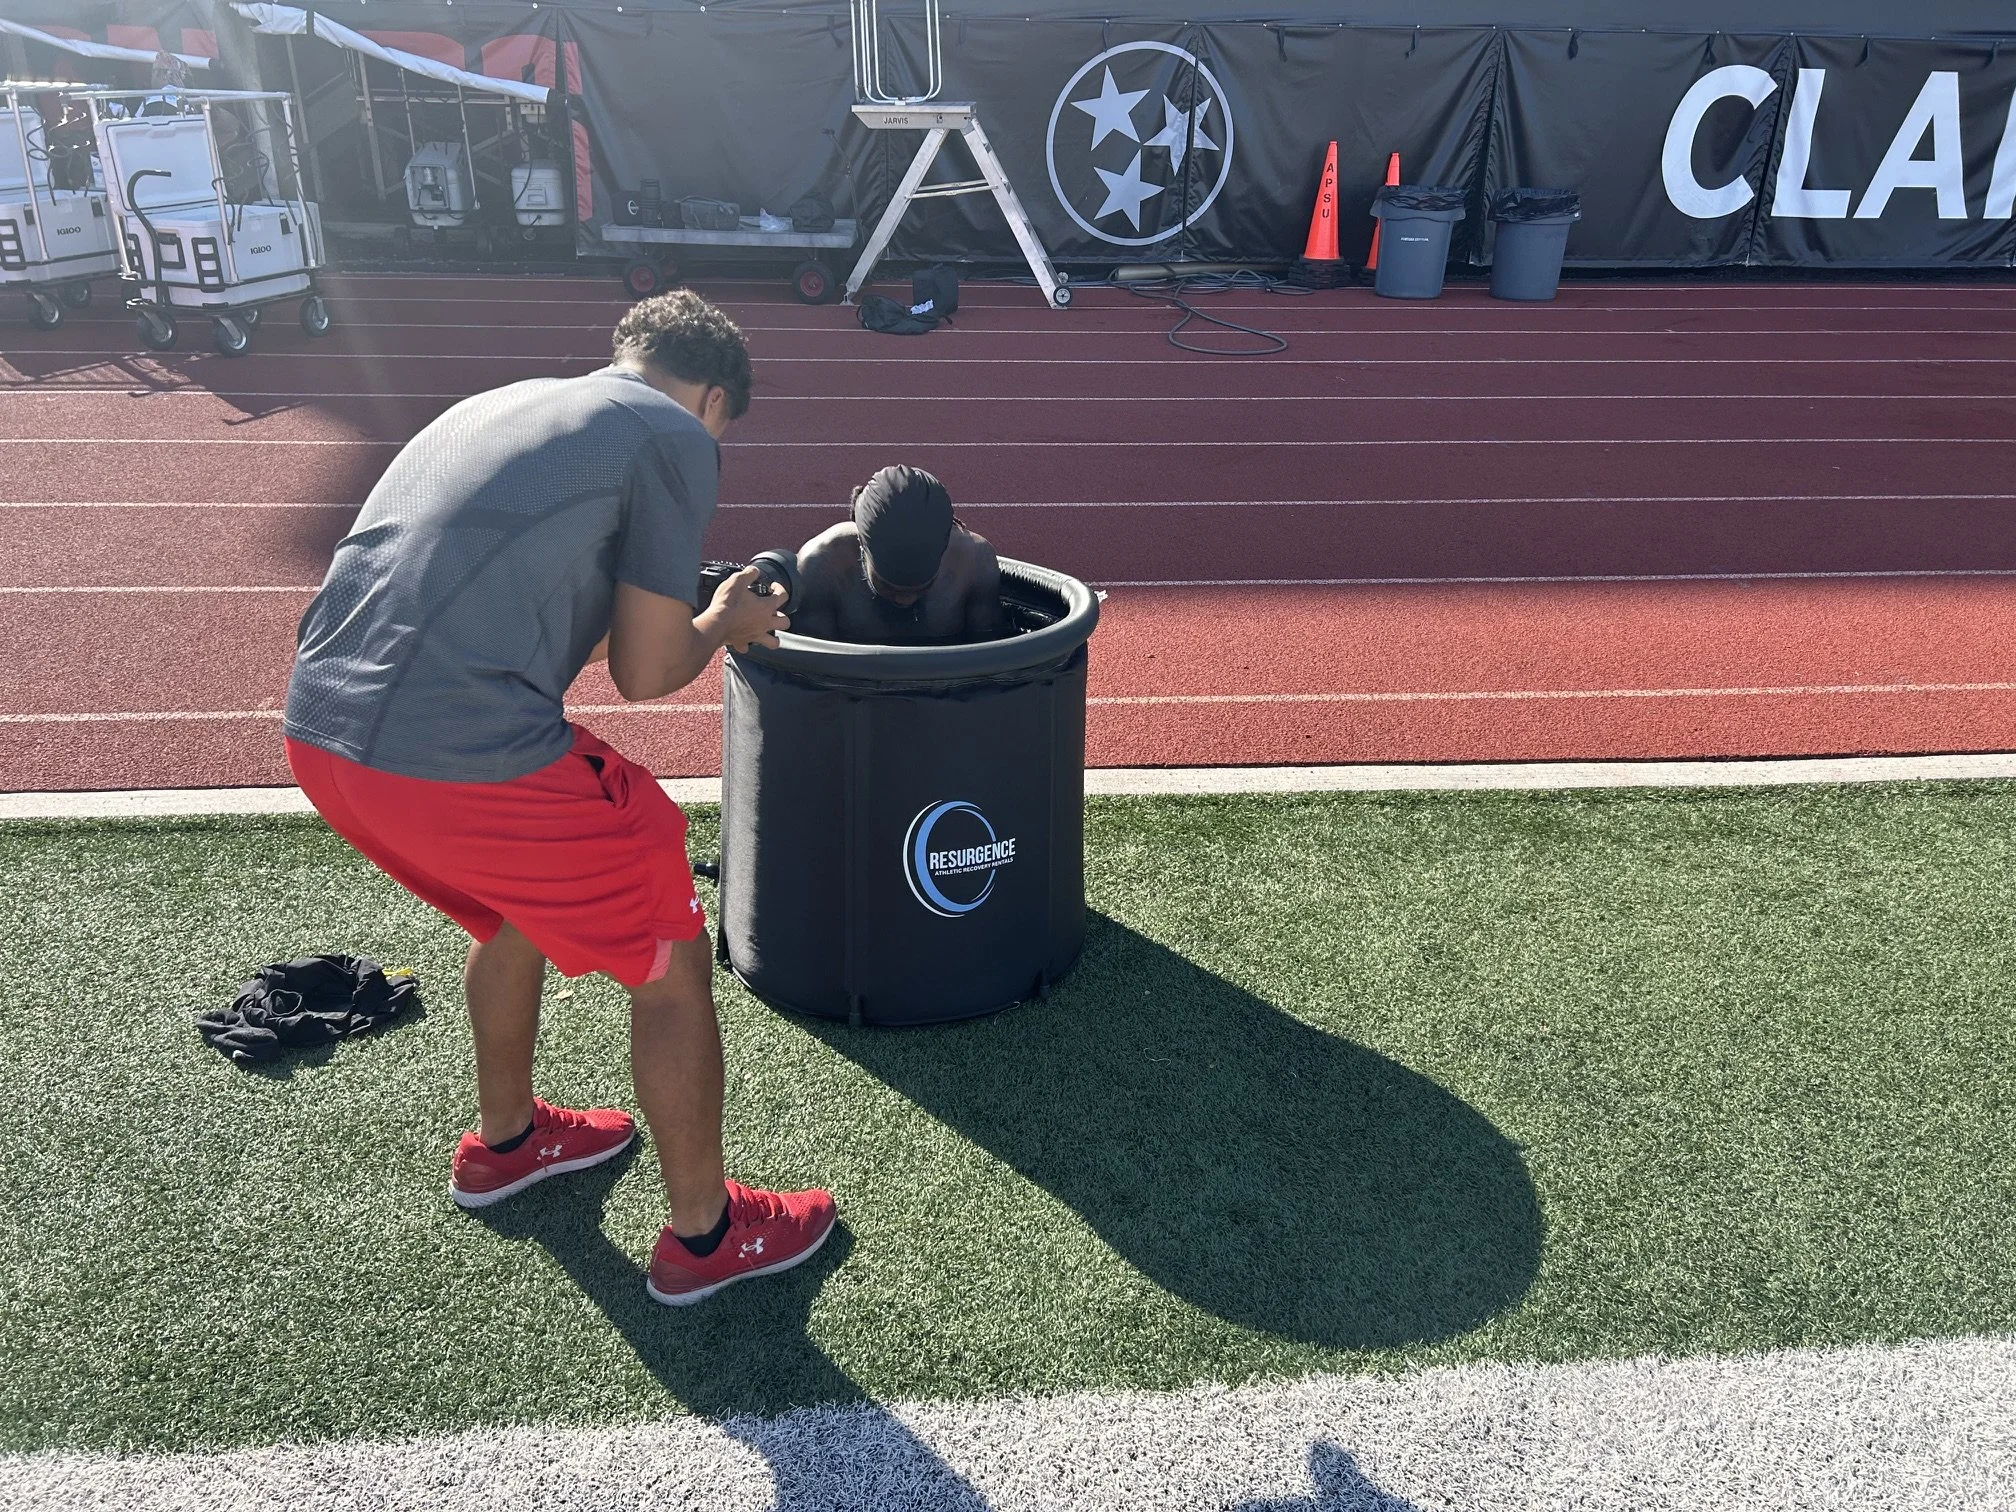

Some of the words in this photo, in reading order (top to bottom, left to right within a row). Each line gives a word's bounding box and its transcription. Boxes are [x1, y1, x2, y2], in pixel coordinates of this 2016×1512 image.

[1661, 64, 2016, 219] CLA
[1322, 163, 1334, 218] APSU
[57, 226, 81, 235] IGLOO
[250, 245, 271, 254] IGLOO
[929, 838, 1015, 869] RESURGENCE
[935, 868, 962, 876] ATHLETIC
[963, 863, 991, 872] RECOVERY
[992, 857, 1013, 867] RENTALS
